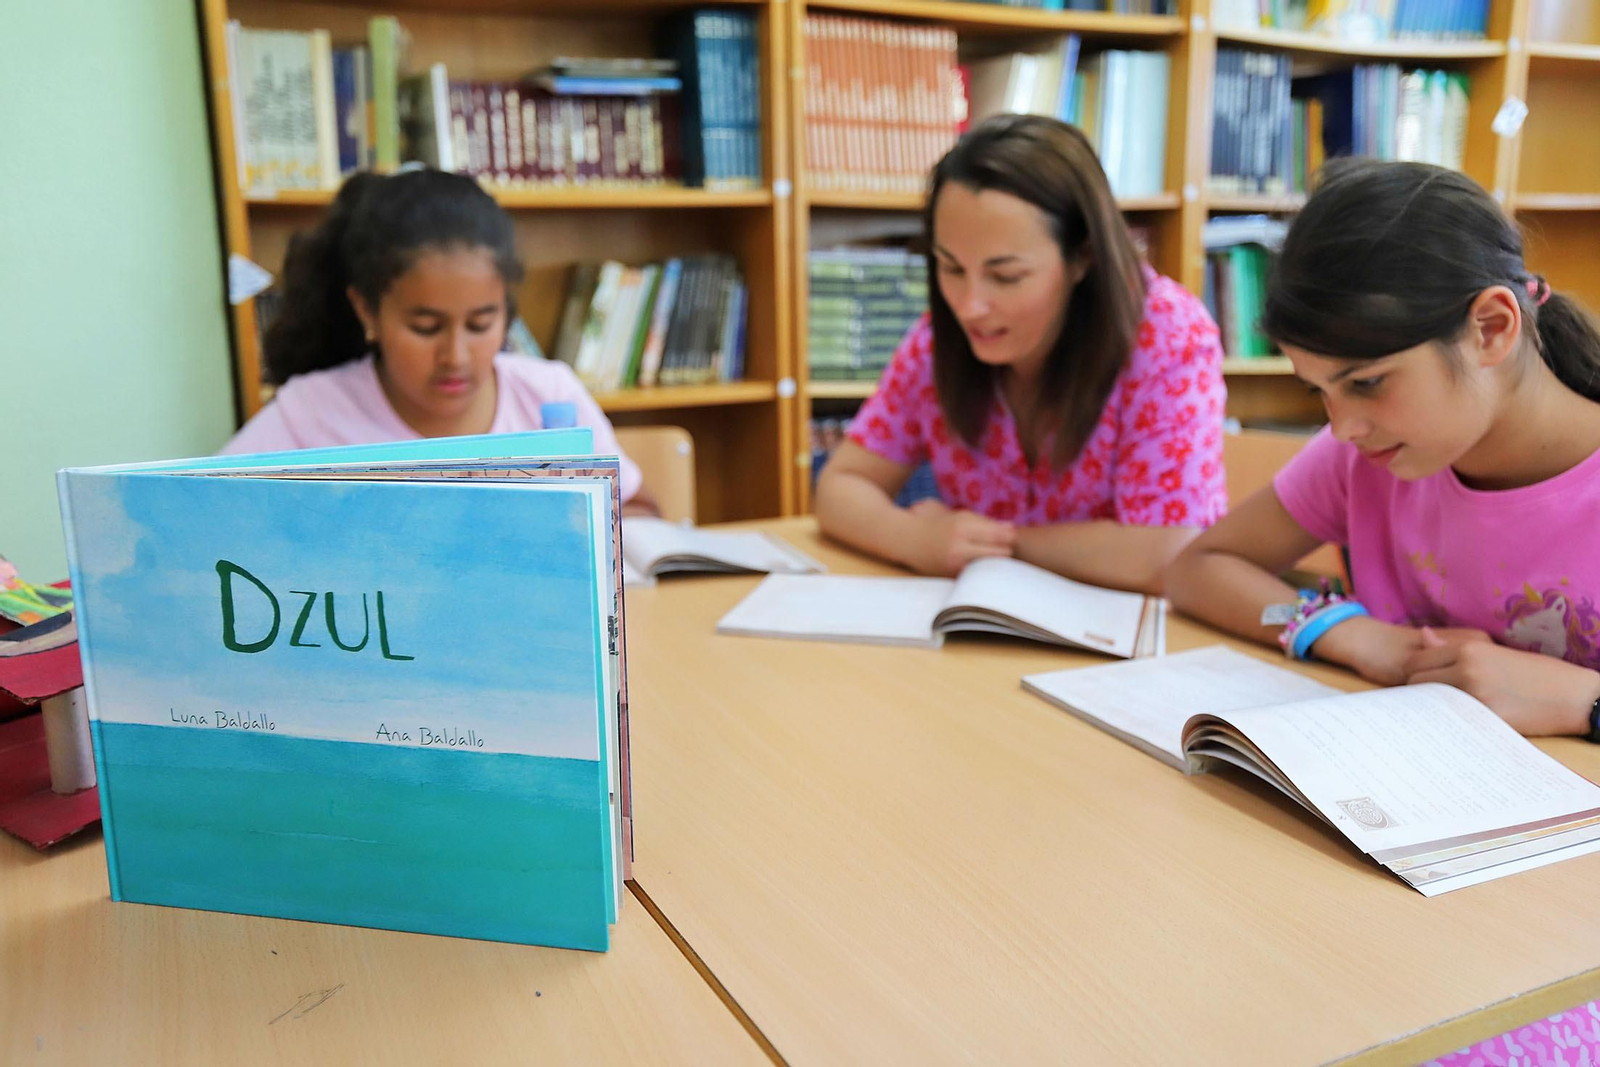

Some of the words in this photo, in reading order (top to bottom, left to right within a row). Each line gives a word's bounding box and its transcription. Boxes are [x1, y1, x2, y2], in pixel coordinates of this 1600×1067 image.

[214, 559, 415, 661] DZUL
[170, 707, 208, 726] Luna
[215, 710, 276, 731] Baldallo
[376, 722, 412, 743] Ana
[420, 727, 485, 748] Baldallo
